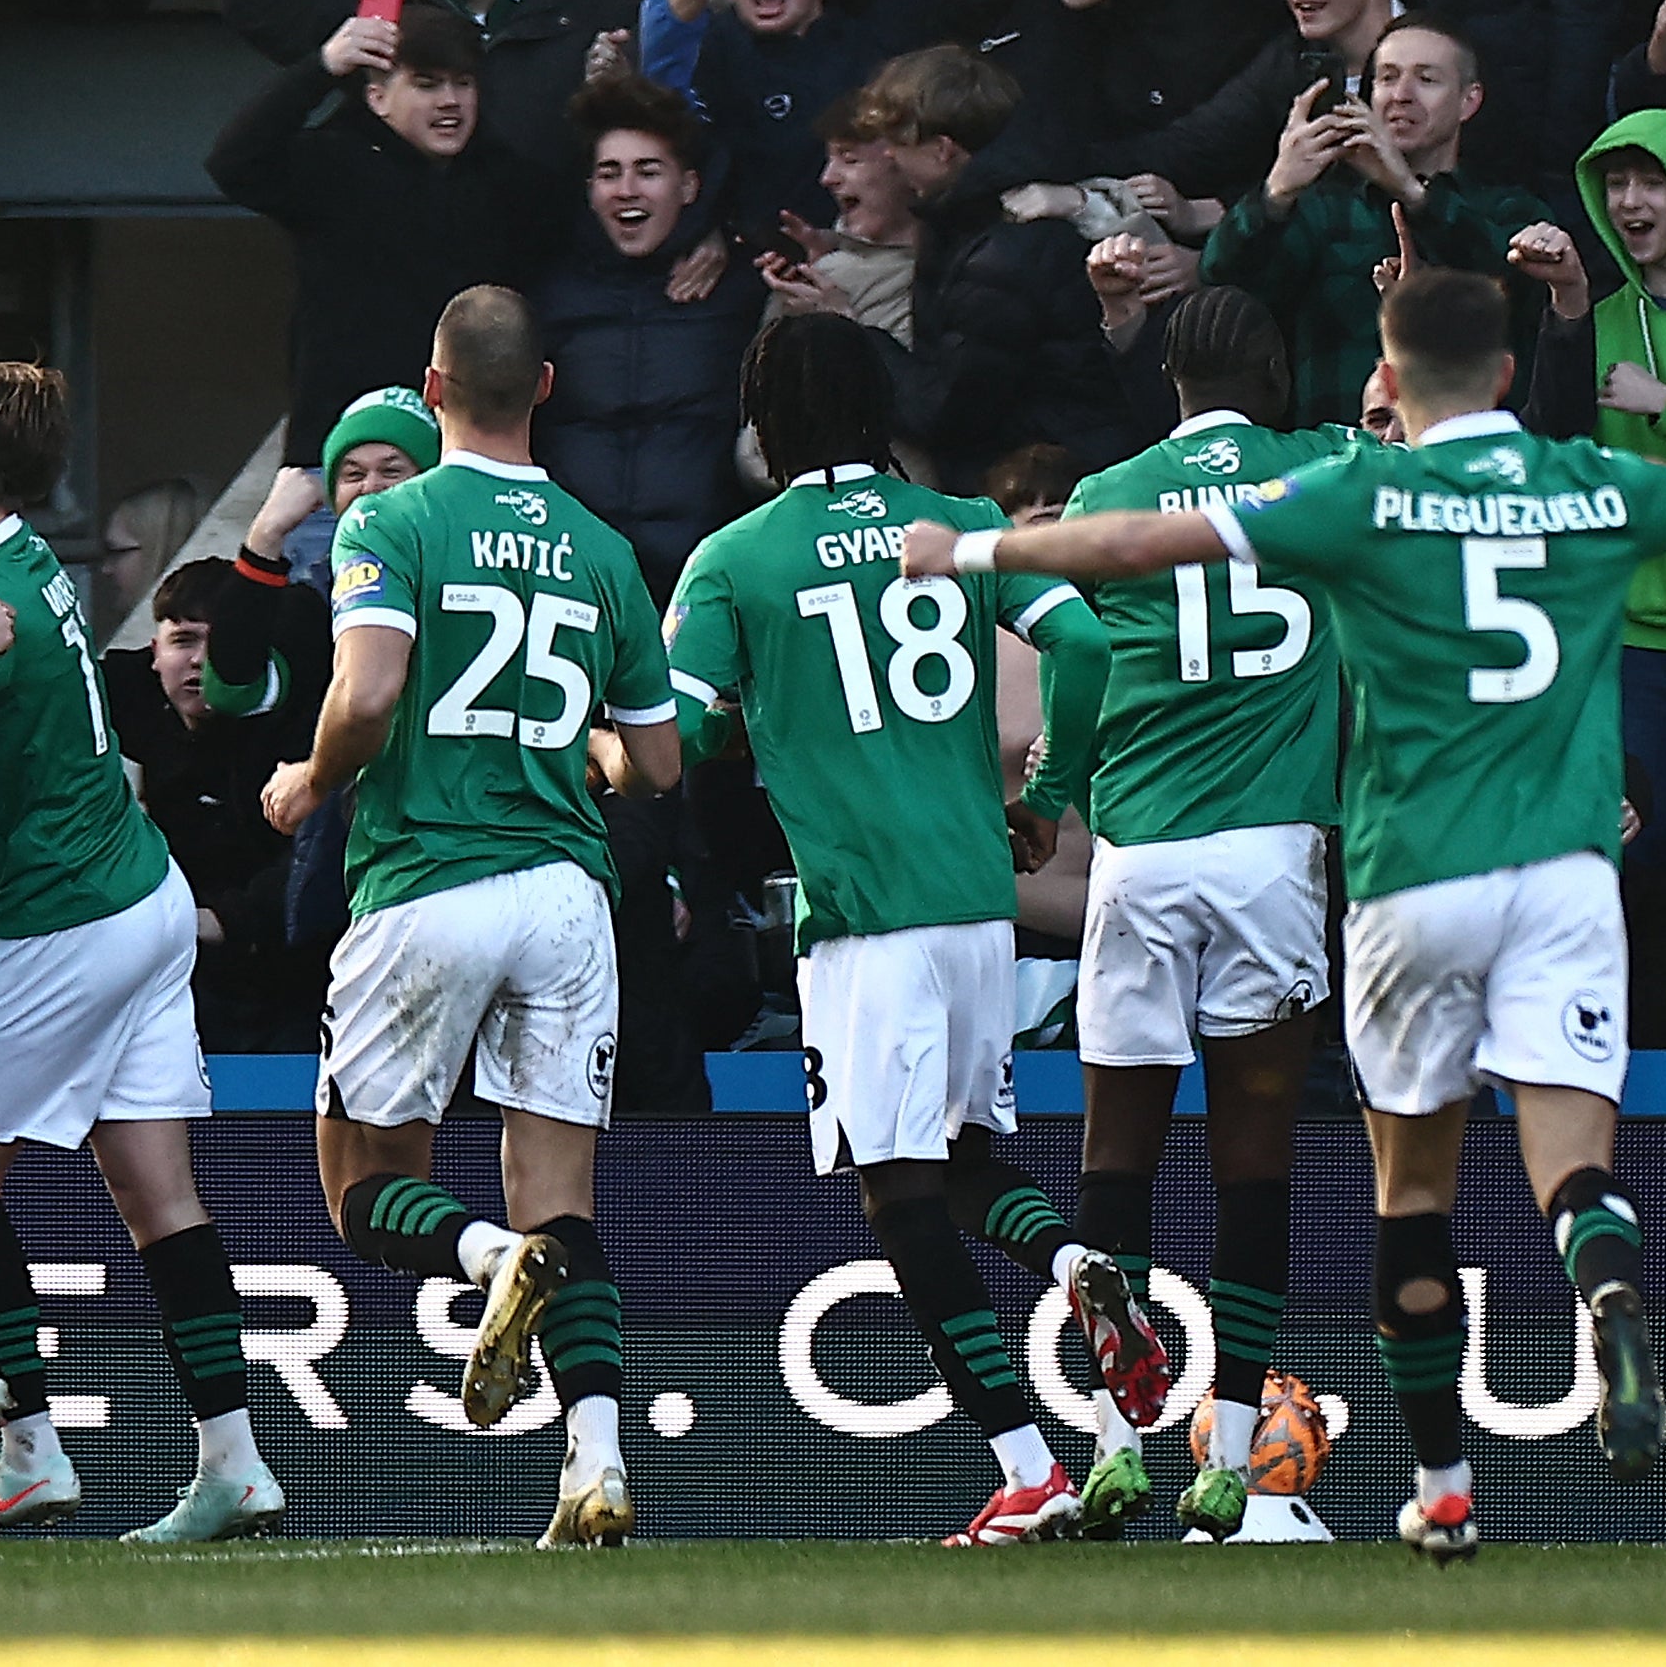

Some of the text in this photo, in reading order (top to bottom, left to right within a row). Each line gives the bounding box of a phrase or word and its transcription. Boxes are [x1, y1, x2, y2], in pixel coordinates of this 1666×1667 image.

[1159, 484, 1262, 515] BUND
[1374, 485, 1628, 535] PLEGUEZUELO
[471, 531, 573, 581] KATIĆ
[817, 523, 915, 569] GYAB
[796, 574, 976, 734] 18
[1173, 556, 1312, 681] 15
[1461, 535, 1560, 703] 5
[427, 584, 600, 749] 25
